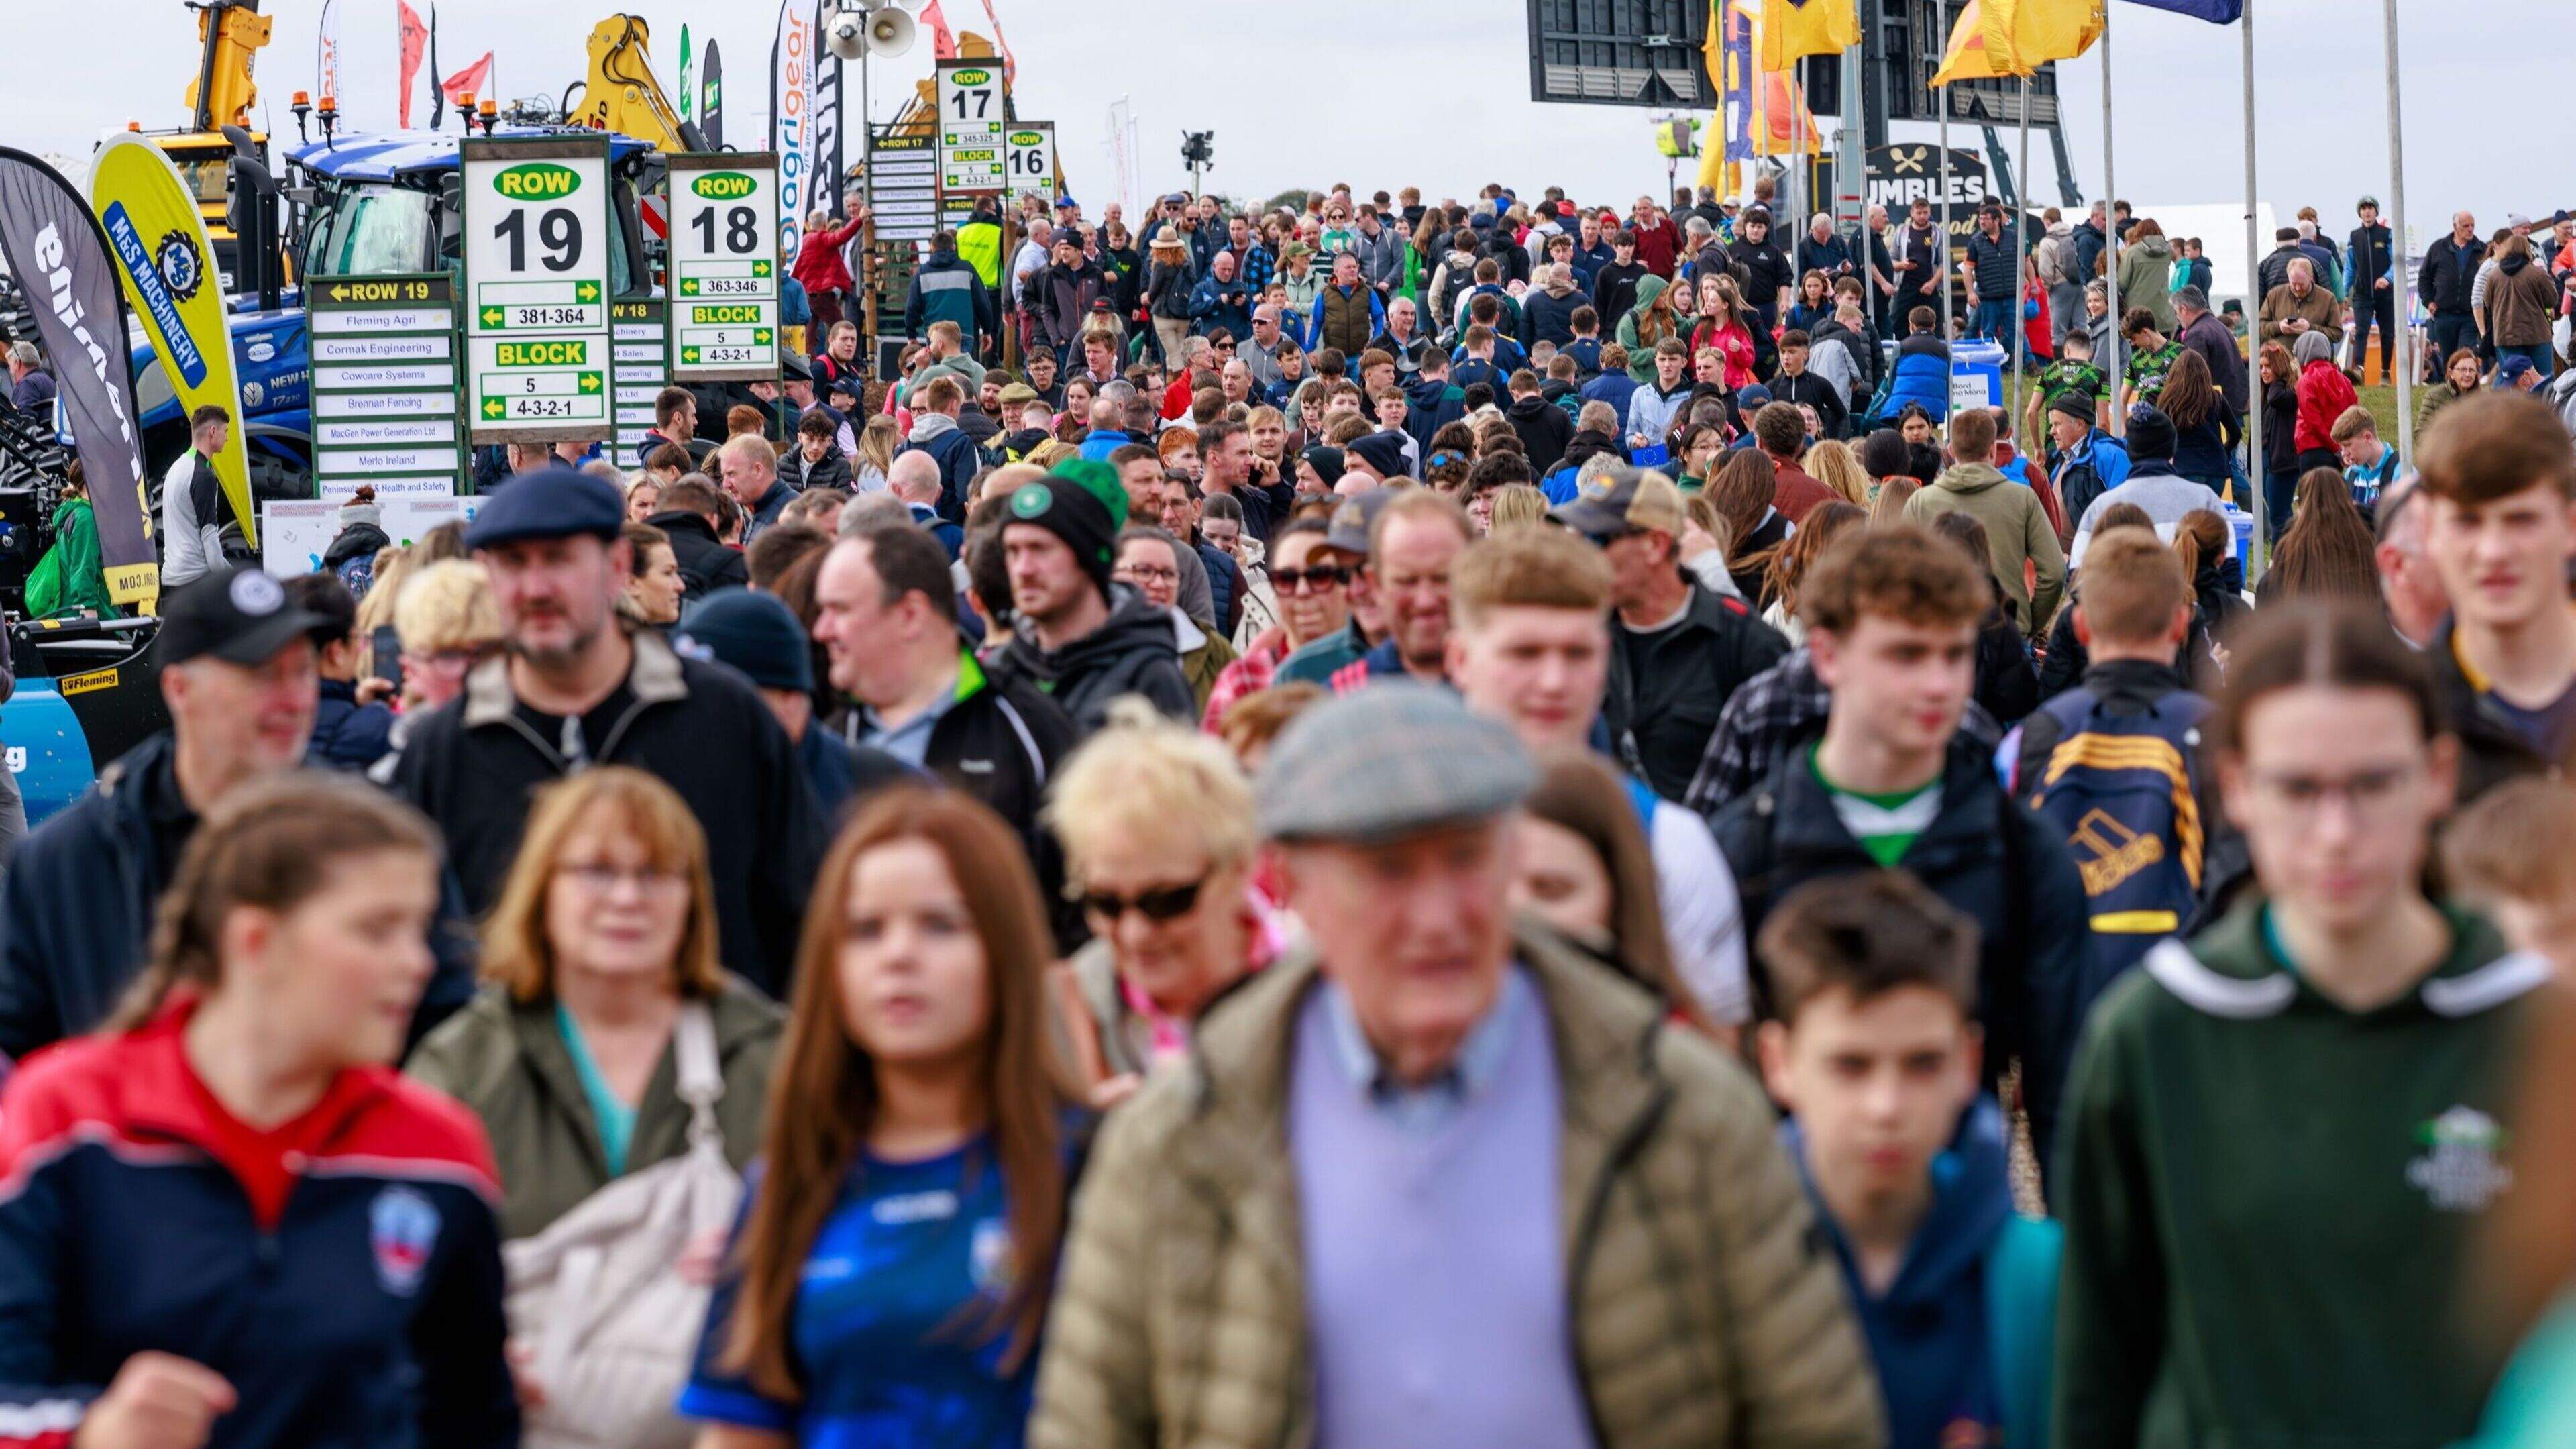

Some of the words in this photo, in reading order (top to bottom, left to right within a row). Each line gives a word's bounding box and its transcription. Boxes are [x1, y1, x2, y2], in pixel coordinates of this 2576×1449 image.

[955, 72, 986, 83] ROW
[780, 8, 804, 209] agrigear
[952, 89, 991, 119] 17
[888, 139, 910, 148] ROW
[912, 138, 923, 147] 17
[1012, 135, 1040, 144] ROW
[954, 150, 993, 161] BLOCK
[1009, 150, 1044, 174] 16
[503, 172, 571, 194] ROW
[698, 178, 750, 195] ROW
[1868, 176, 1985, 206] UMBLES
[692, 206, 758, 254] 18
[111, 216, 141, 264] M&S
[494, 209, 582, 272] 19
[352, 282, 398, 301] ROW
[405, 282, 429, 299] 19
[708, 280, 757, 292] 363-346
[133, 260, 198, 370] MACHINERY
[519, 308, 584, 325] 381-364
[629, 304, 647, 317] 18
[694, 307, 758, 323] BLOCK
[346, 315, 389, 327] Fleming
[393, 315, 416, 325] Agri
[614, 328, 646, 336] chinery
[718, 332, 725, 343] 5
[327, 343, 366, 354] Cormak
[370, 343, 432, 354] Engineering
[498, 343, 583, 365] BLOCK
[710, 349, 751, 360] 4-3-2-1
[270, 373, 299, 390] NEW
[341, 371, 382, 381] Cowcare
[386, 370, 425, 382] Systems
[526, 378, 535, 392] 5
[347, 398, 385, 409] Brennan
[388, 397, 422, 409] Fencing
[517, 400, 571, 415] 4-3-2-1
[331, 429, 359, 438] MacGen
[361, 428, 382, 437] Power
[384, 427, 422, 437] Generation
[424, 427, 436, 436] Ltd
[359, 456, 383, 466] Merlo
[386, 455, 415, 465] Ireland
[374, 484, 380, 492] &
[382, 483, 405, 492] Health
[407, 483, 421, 492] and
[423, 482, 446, 492] Safety
[74, 673, 115, 688] Fleming
